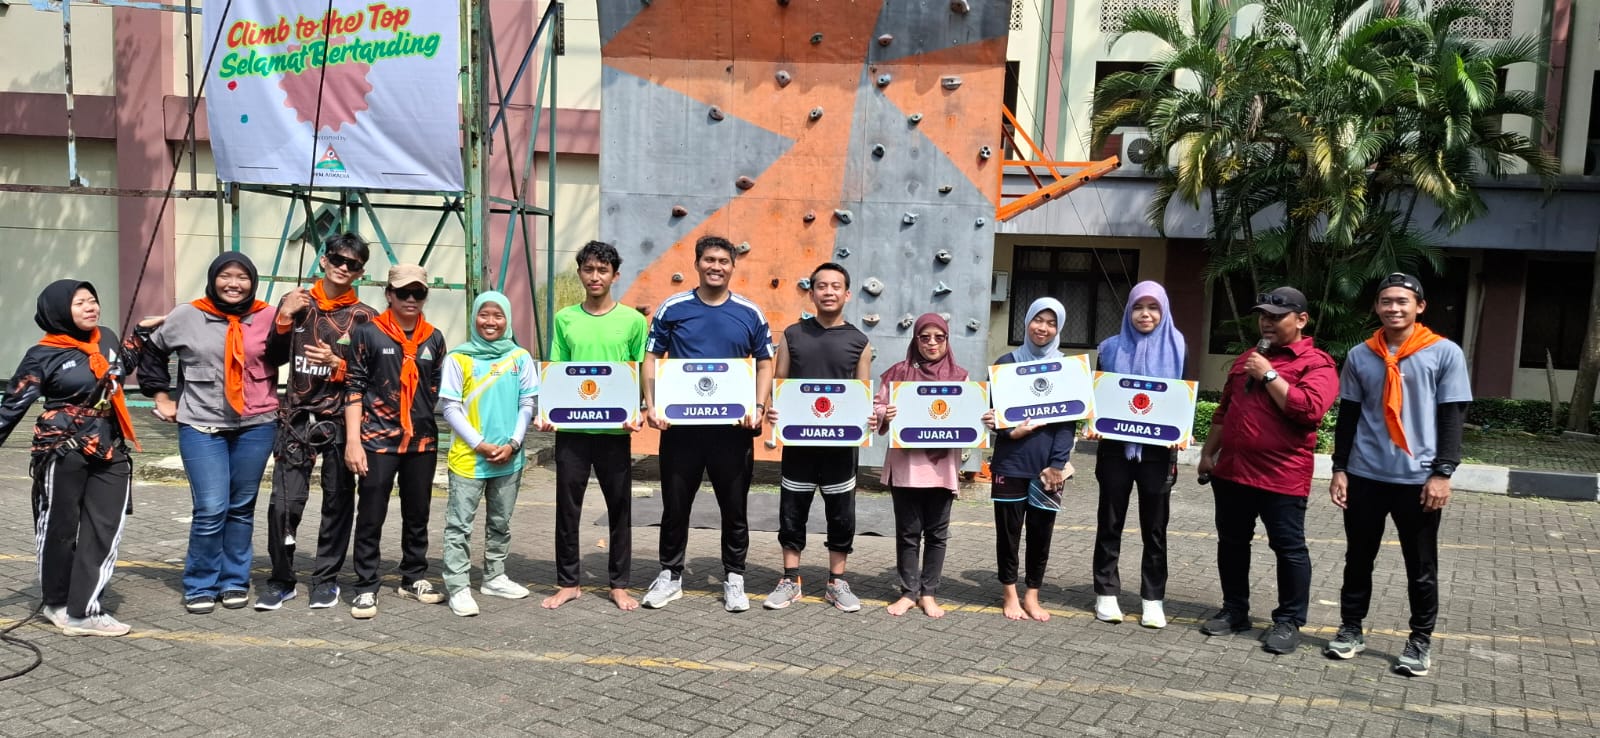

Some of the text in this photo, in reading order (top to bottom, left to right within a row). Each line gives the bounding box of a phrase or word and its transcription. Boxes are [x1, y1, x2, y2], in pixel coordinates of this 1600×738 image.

[226, 4, 410, 48] Climb to the Top
[219, 32, 441, 79] Selamat Bertanding
[567, 410, 610, 420] JUARA 1
[682, 406, 728, 416] JUARA 2
[1022, 403, 1068, 418] JUARA 2
[799, 428, 845, 438] JUARA 3
[917, 430, 960, 440] JUARA 1
[1113, 422, 1161, 436] JUARA 3
